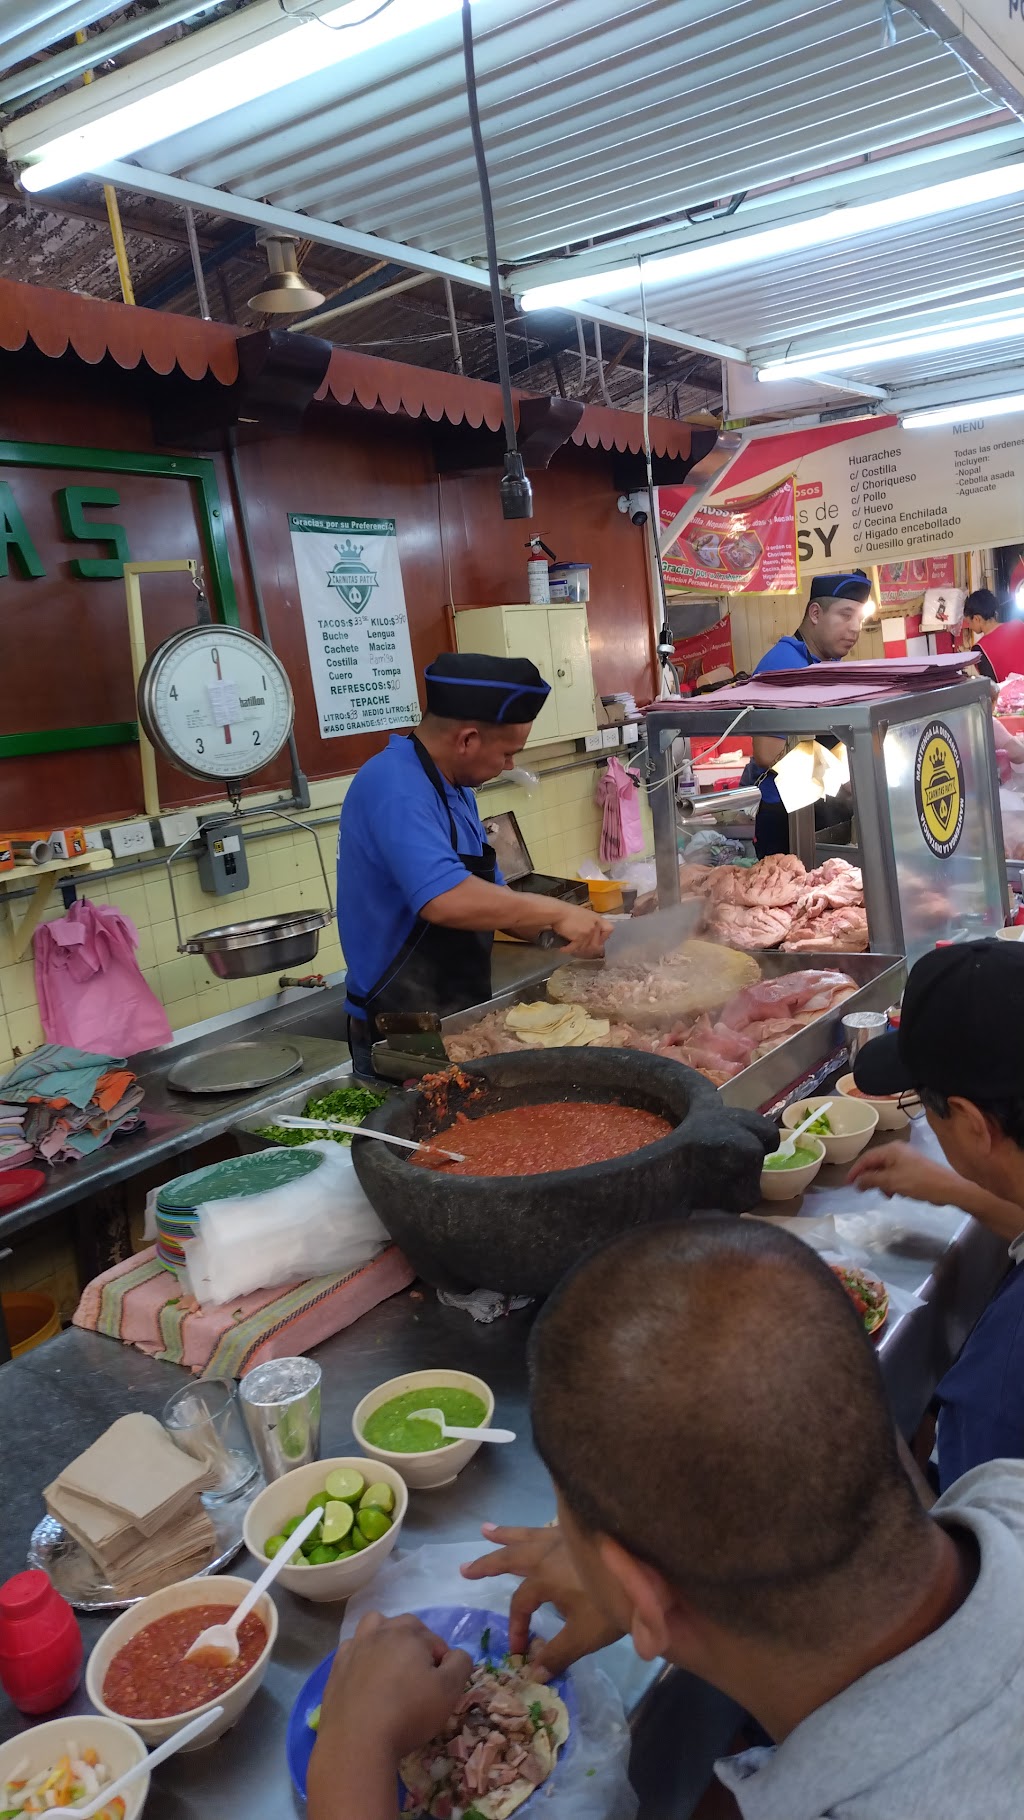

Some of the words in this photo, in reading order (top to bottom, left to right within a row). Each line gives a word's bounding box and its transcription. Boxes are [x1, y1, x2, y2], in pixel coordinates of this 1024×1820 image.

[954, 447, 977, 458] Todas
[979, 446, 991, 454] las
[993, 438, 1024, 451] ordenes
[848, 448, 902, 466] Huaraches
[954, 455, 990, 468] incluyen:
[849, 470, 859, 481] c/
[861, 464, 897, 478] Costilla
[990, 469, 1015, 482] asada
[850, 483, 860, 493] c/
[862, 473, 917, 491] Choriqueso
[851, 494, 860, 505] c/
[863, 491, 887, 503] Pollo
[815, 502, 839, 520] de
[851, 507, 861, 517] c/
[864, 502, 894, 515] Huevo
[852, 519, 862, 530] c/
[864, 515, 897, 528] Cecina
[899, 505, 948, 522] Enchilada
[326, 521, 338, 529] por
[351, 521, 394, 531] Preferenci
[853, 531, 862, 542] c/
[901, 516, 961, 534] encebollado
[854, 543, 863, 554] c/
[866, 538, 904, 552] Quesillo
[906, 530, 954, 547] gratinado
[662, 561, 694, 575] Gracias
[322, 632, 349, 641] Buche
[367, 630, 396, 640] Lengua
[324, 644, 359, 654] Cachete
[369, 642, 396, 651] Maciza
[326, 657, 358, 667] Costilla
[329, 672, 353, 681] Cuero
[372, 667, 401, 677] Trompa
[169, 685, 179, 702] 4
[350, 695, 390, 708] TEPACHE
[362, 708, 384, 717] MEDIO
[252, 730, 261, 746] 2
[195, 738, 205, 754] 3
